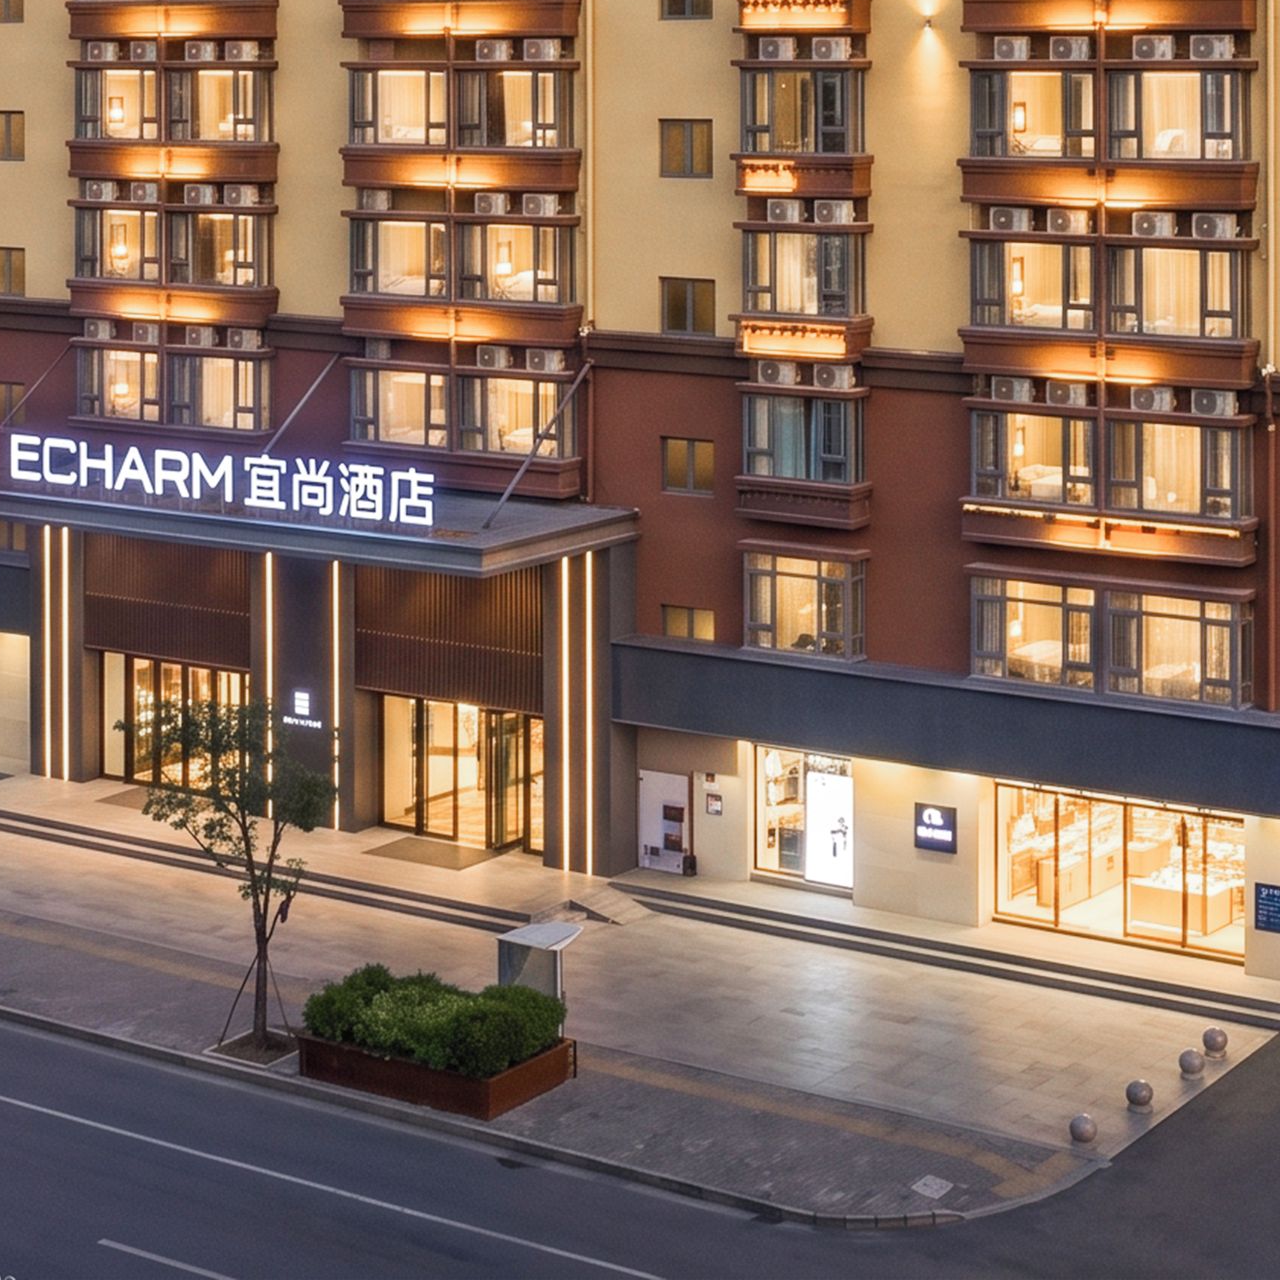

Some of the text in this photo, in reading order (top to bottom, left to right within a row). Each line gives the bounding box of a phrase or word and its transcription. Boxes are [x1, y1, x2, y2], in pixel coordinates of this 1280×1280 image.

[10, 434, 434, 526] ECHARM 宜尚酒店
